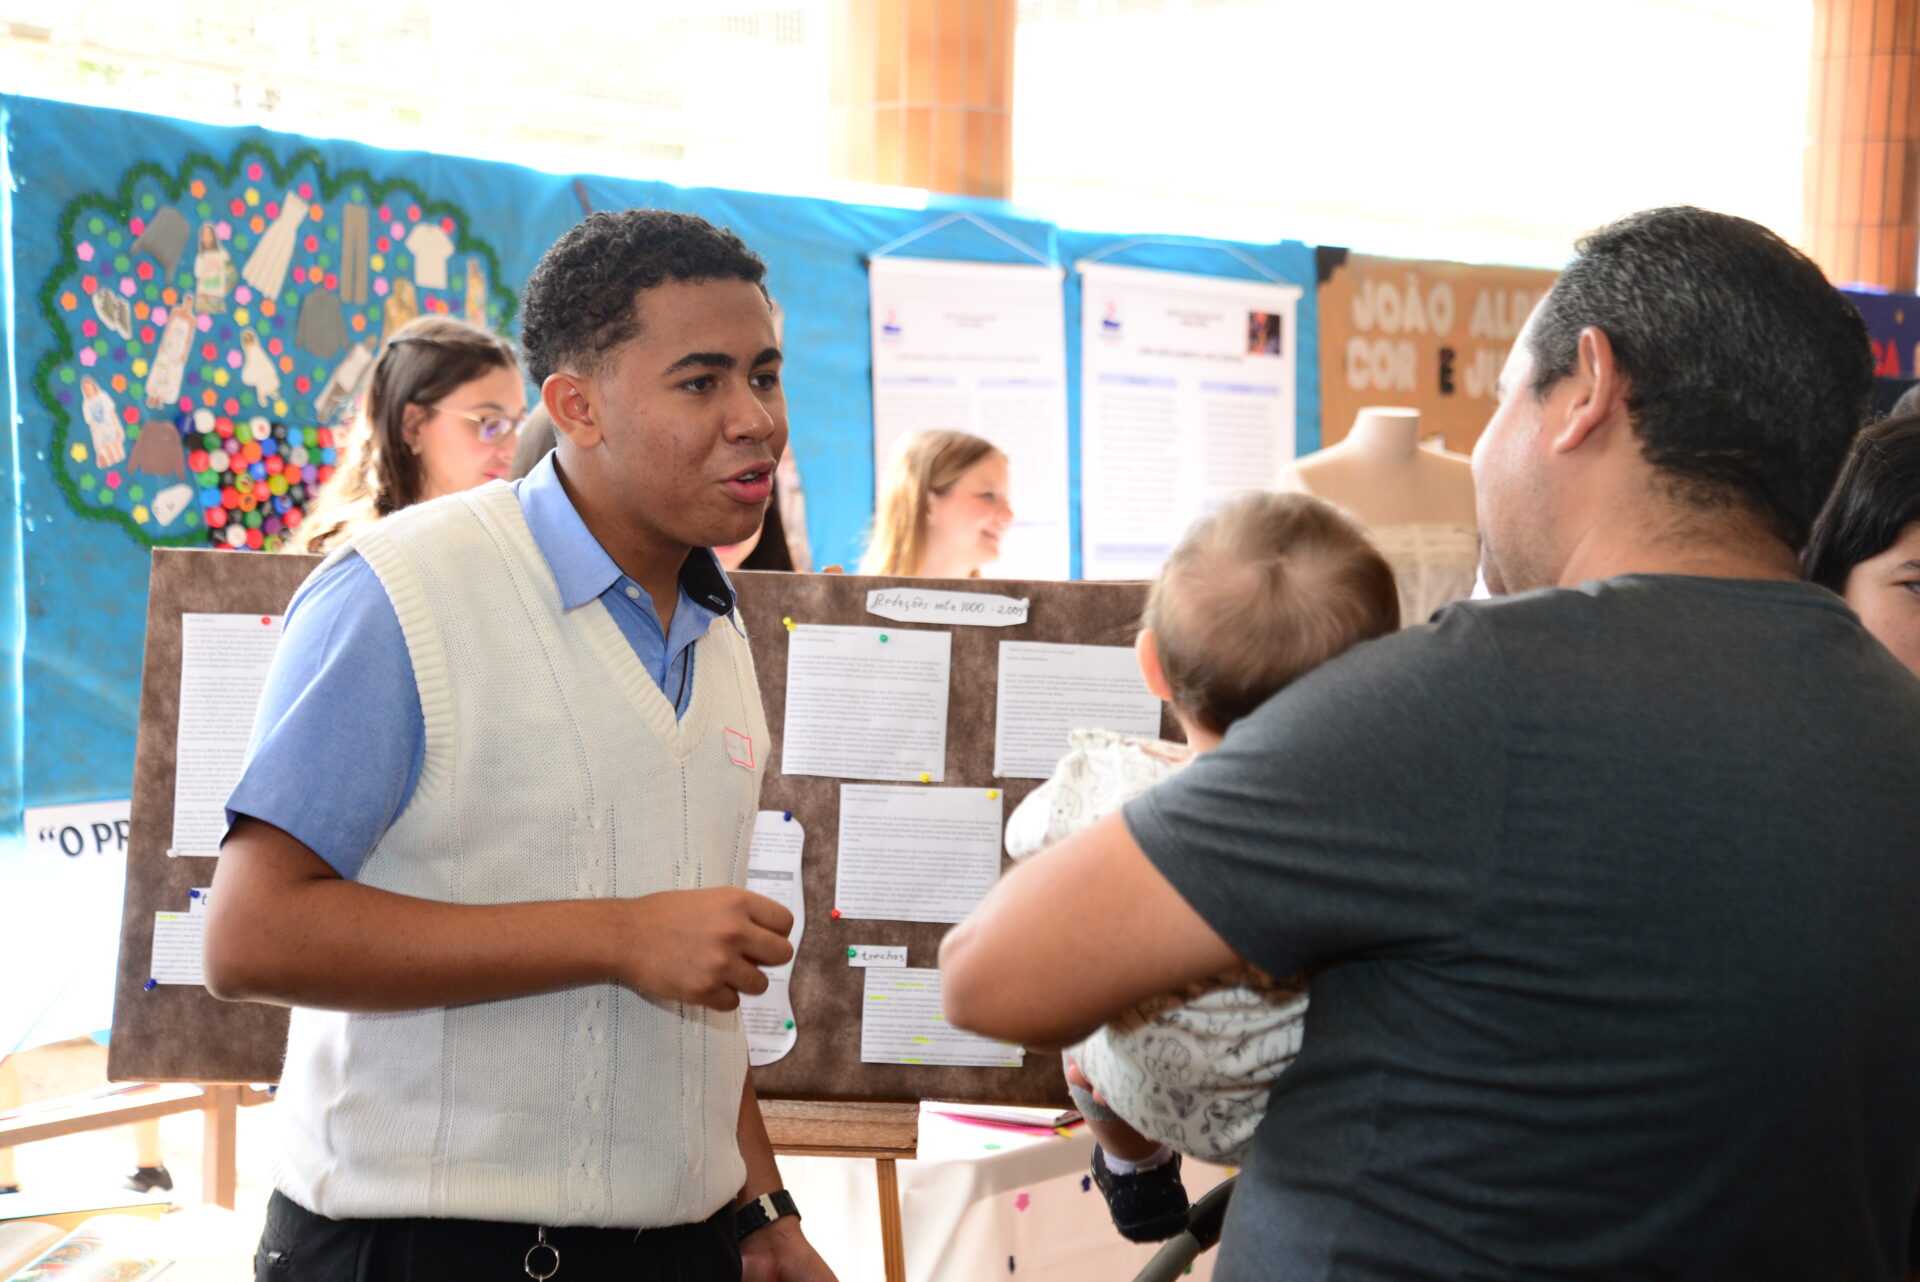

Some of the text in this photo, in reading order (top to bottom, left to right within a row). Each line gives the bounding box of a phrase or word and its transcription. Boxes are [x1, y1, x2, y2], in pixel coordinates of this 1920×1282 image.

[1352, 273, 1545, 340] JOÃO ALB
[1346, 336, 1417, 392] COR
[960, 602, 985, 614] 1000
